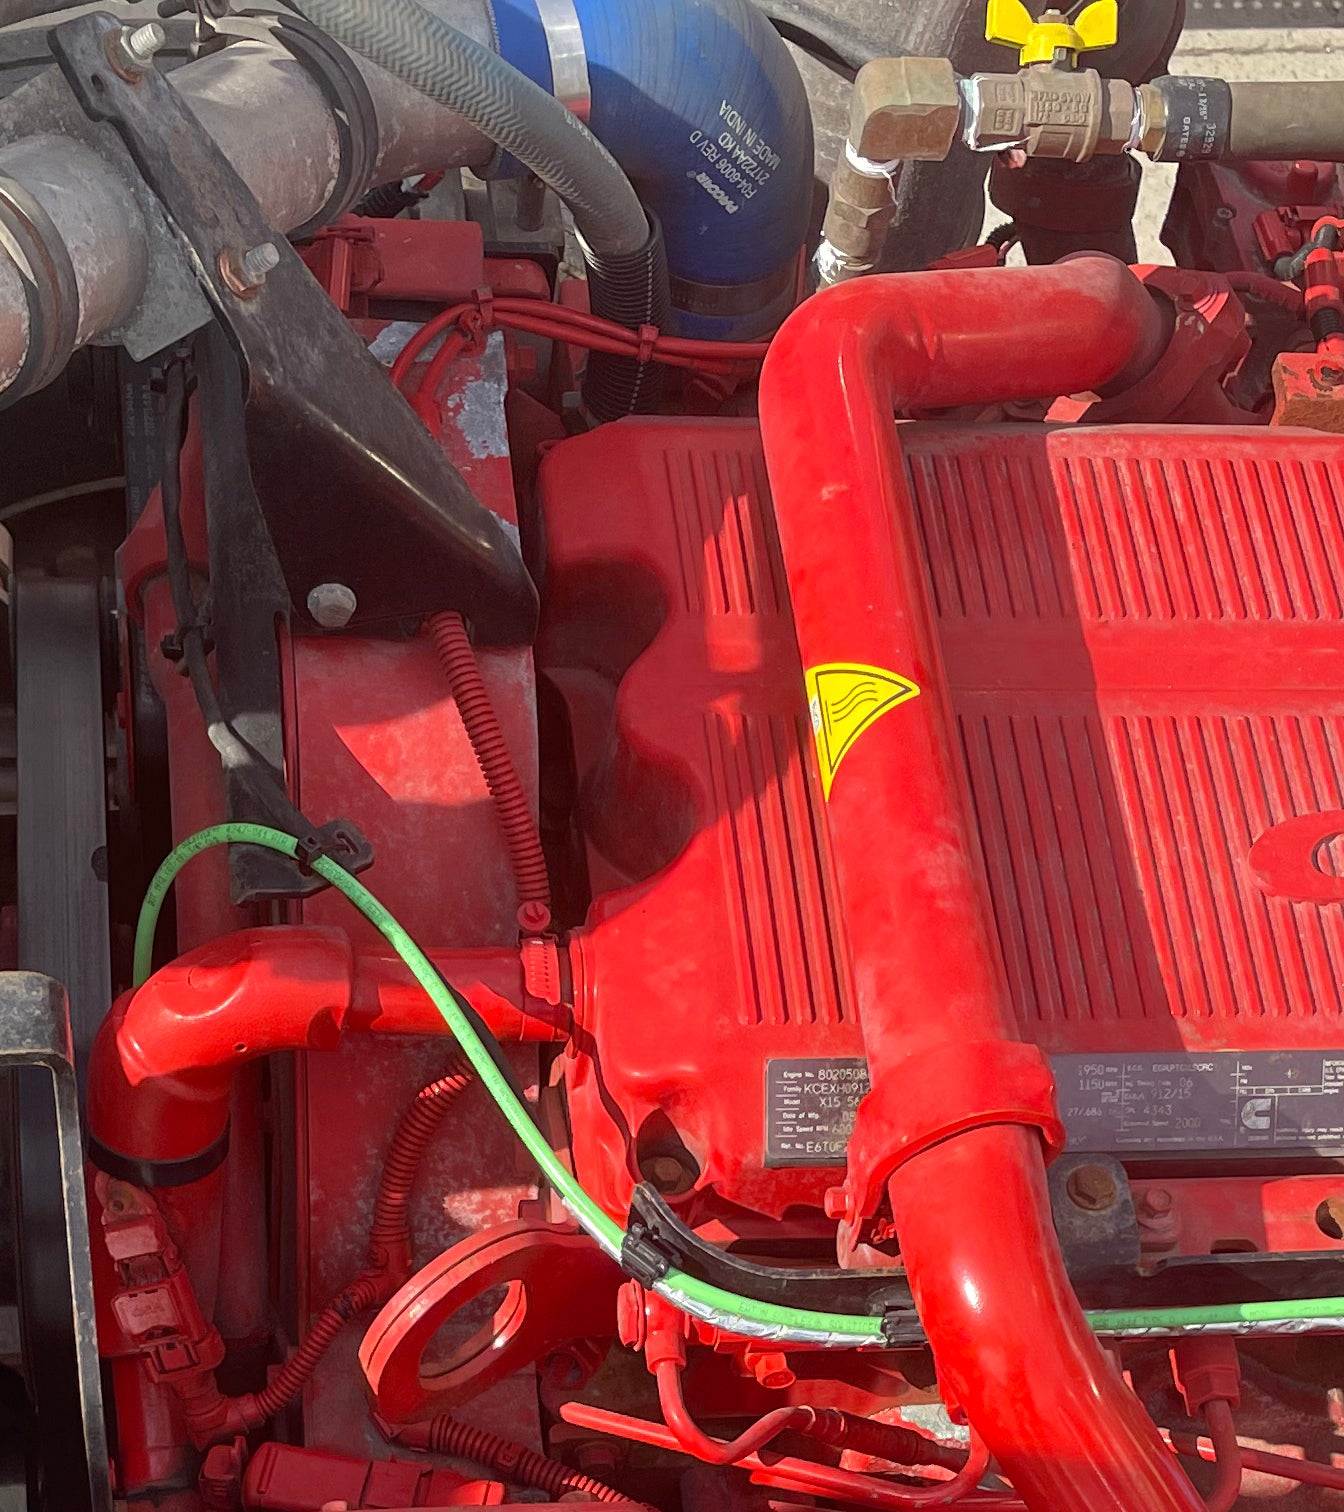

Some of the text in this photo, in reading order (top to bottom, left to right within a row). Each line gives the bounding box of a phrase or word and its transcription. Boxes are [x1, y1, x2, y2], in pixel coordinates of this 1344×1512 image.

[689, 130, 702, 144] D
[718, 132, 736, 153] KD
[719, 99, 782, 170] MADE IN INDIA
[696, 140, 722, 162] REV
[783, 1071, 802, 1079] Engine
[818, 1068, 868, 1081] 8020508
[819, 1096, 841, 1108] X15
